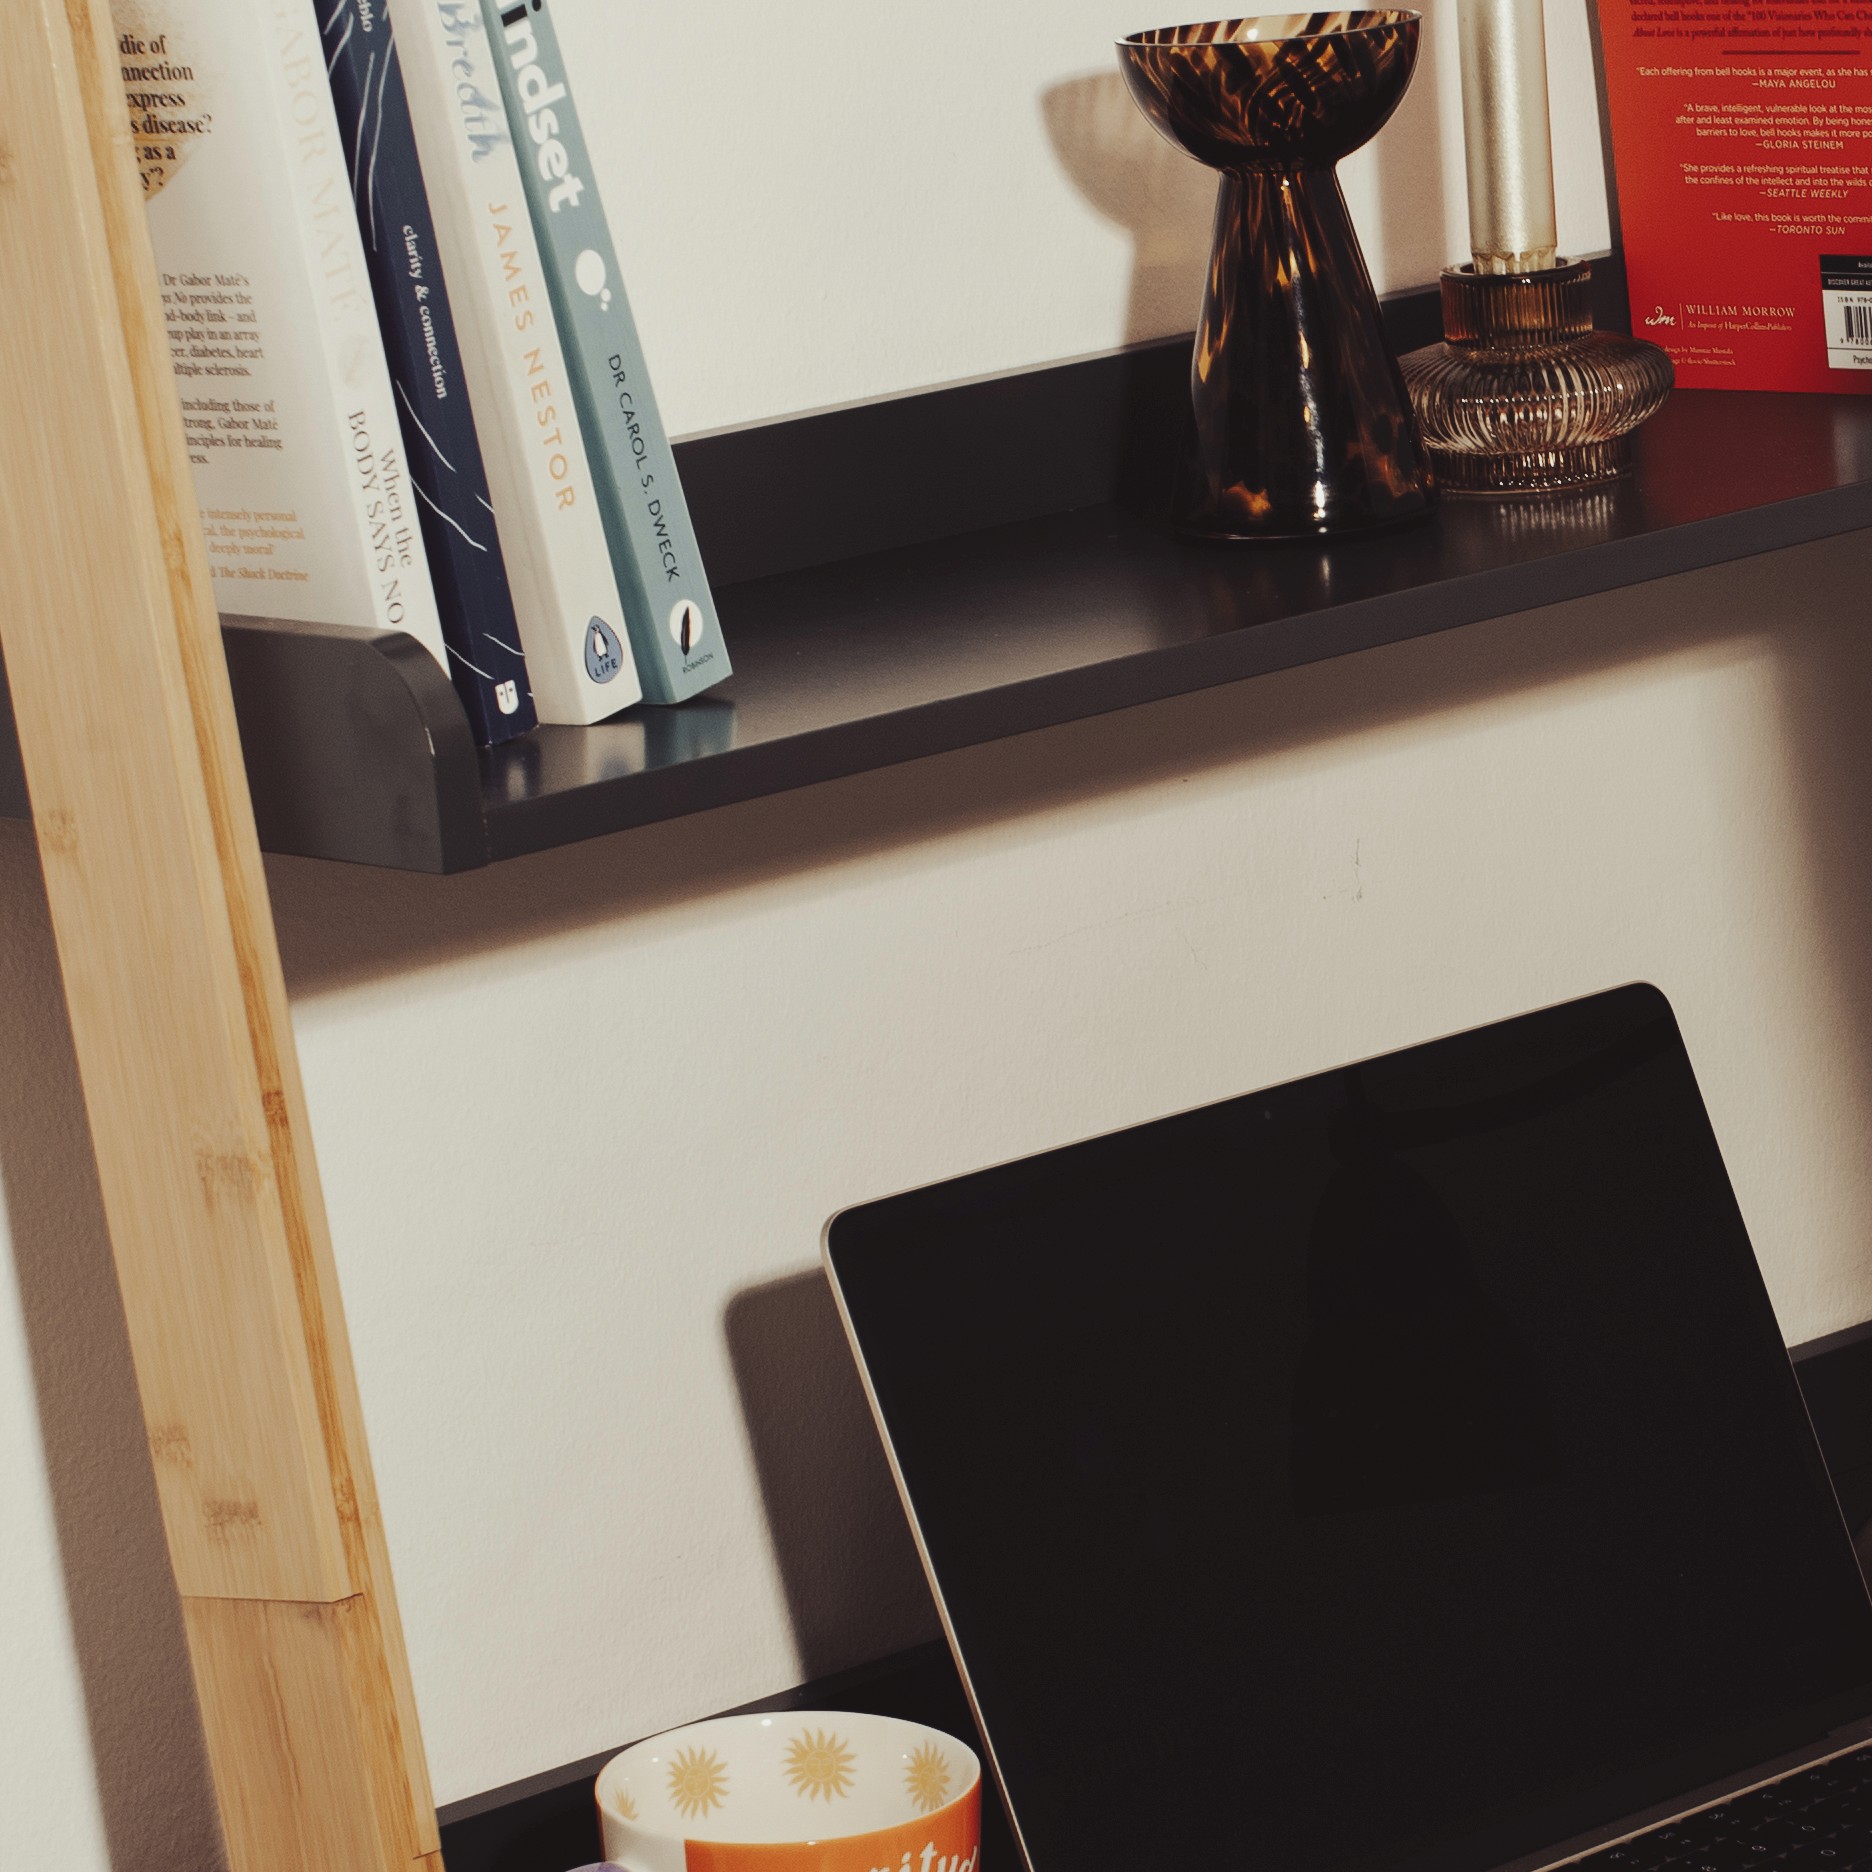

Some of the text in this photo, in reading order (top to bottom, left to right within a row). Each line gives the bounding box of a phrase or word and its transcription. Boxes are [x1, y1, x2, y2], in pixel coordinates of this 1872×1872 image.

[150, 36, 168, 56] of
[437, 0, 511, 163] Breath
[1789, 79, 1836, 89] ANGELOU
[144, 146, 176, 160] as a
[1802, 140, 1844, 150] STEINEM
[403, 224, 447, 399] clarity & connection
[1686, 304, 1795, 318] WILLIAM MORROW
[488, 201, 576, 511] JAMES NESTOR
[608, 354, 680, 582] DR CAROL S. DWECK
[348, 409, 405, 624] BODY SAYS NO
[380, 448, 413, 569] When the
[593, 661, 618, 678] LIFE
[681, 652, 714, 674] ROBINSON
